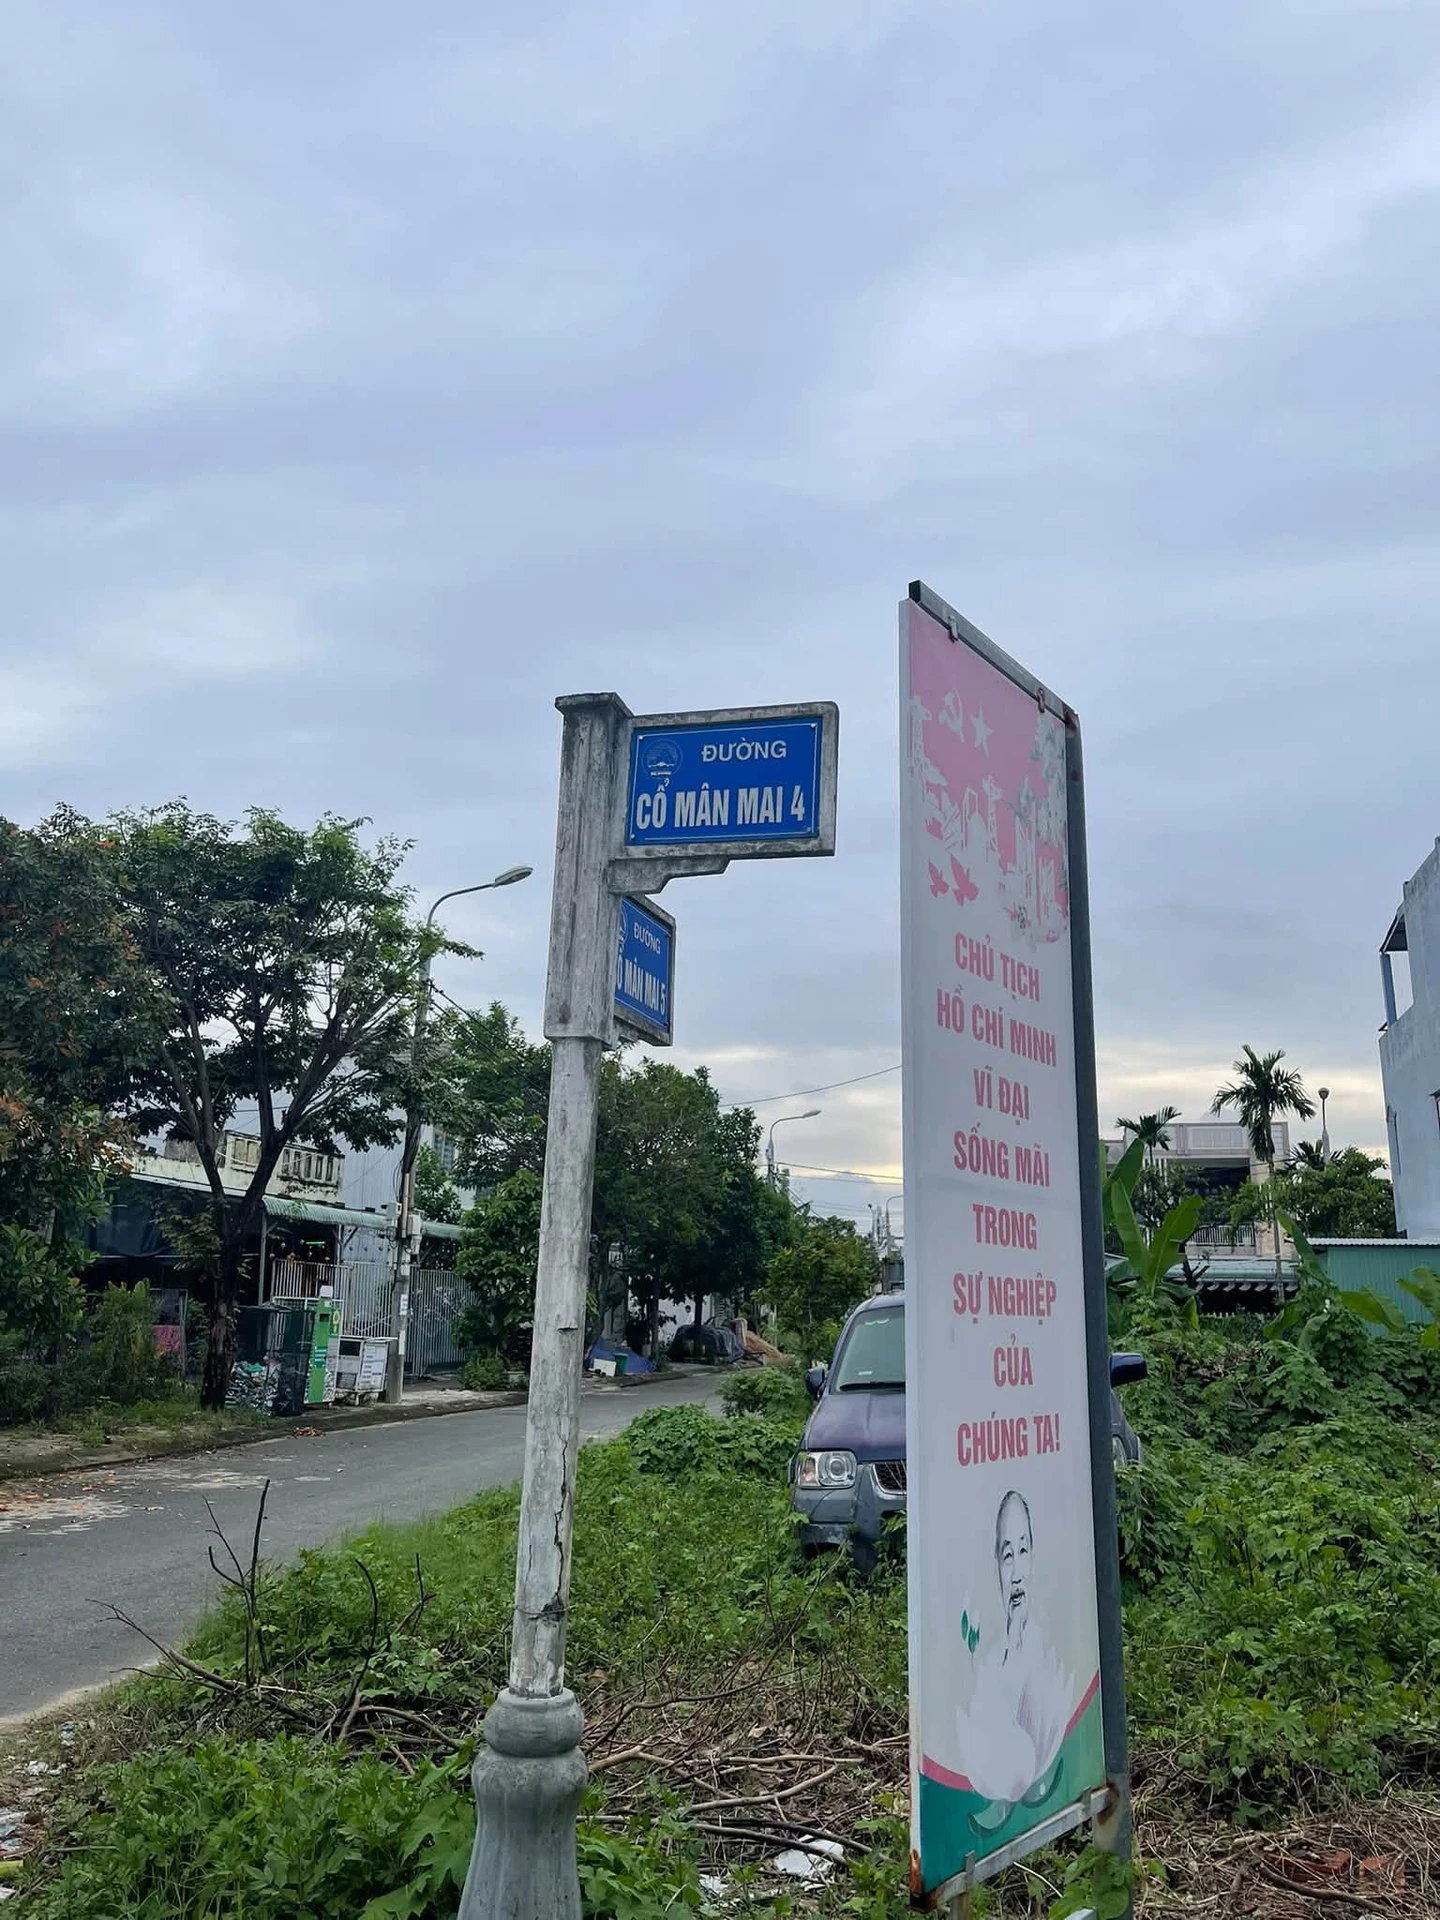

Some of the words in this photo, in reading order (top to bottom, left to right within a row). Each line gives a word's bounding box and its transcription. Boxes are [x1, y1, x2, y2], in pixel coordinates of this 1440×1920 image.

[701, 736, 787, 762] ĐƯỜNG
[636, 778, 670, 830] CỔ
[674, 783, 729, 828] MÂN
[737, 786, 783, 825] MAI
[790, 785, 805, 821] 4
[633, 922, 661, 955] ĐƯỜNG
[616, 942, 625, 991] Ổ
[624, 957, 644, 1003] MÂN
[645, 970, 660, 1012] MAI
[660, 981, 666, 1016] 5
[955, 933, 994, 982] CHỦ
[1000, 952, 1040, 1002] TỊCH
[937, 983, 965, 1035] HỒ
[971, 1004, 1004, 1049] CHÍ
[1010, 1018, 1057, 1067] MINH
[973, 1065, 992, 1109] VĨ
[998, 1076, 1029, 1126] ĐẠI
[953, 1121, 1009, 1179] SỐNG
[1015, 1143, 1050, 1188] MÃI
[972, 1203, 1037, 1250] TRONG
[953, 1270, 983, 1325] SỰ
[988, 1271, 1057, 1326] NGHIỆP
[993, 1333, 1033, 1388] CỦA
[957, 1411, 1028, 1467] CHÚNG
[1033, 1413, 1060, 1454] TA!
